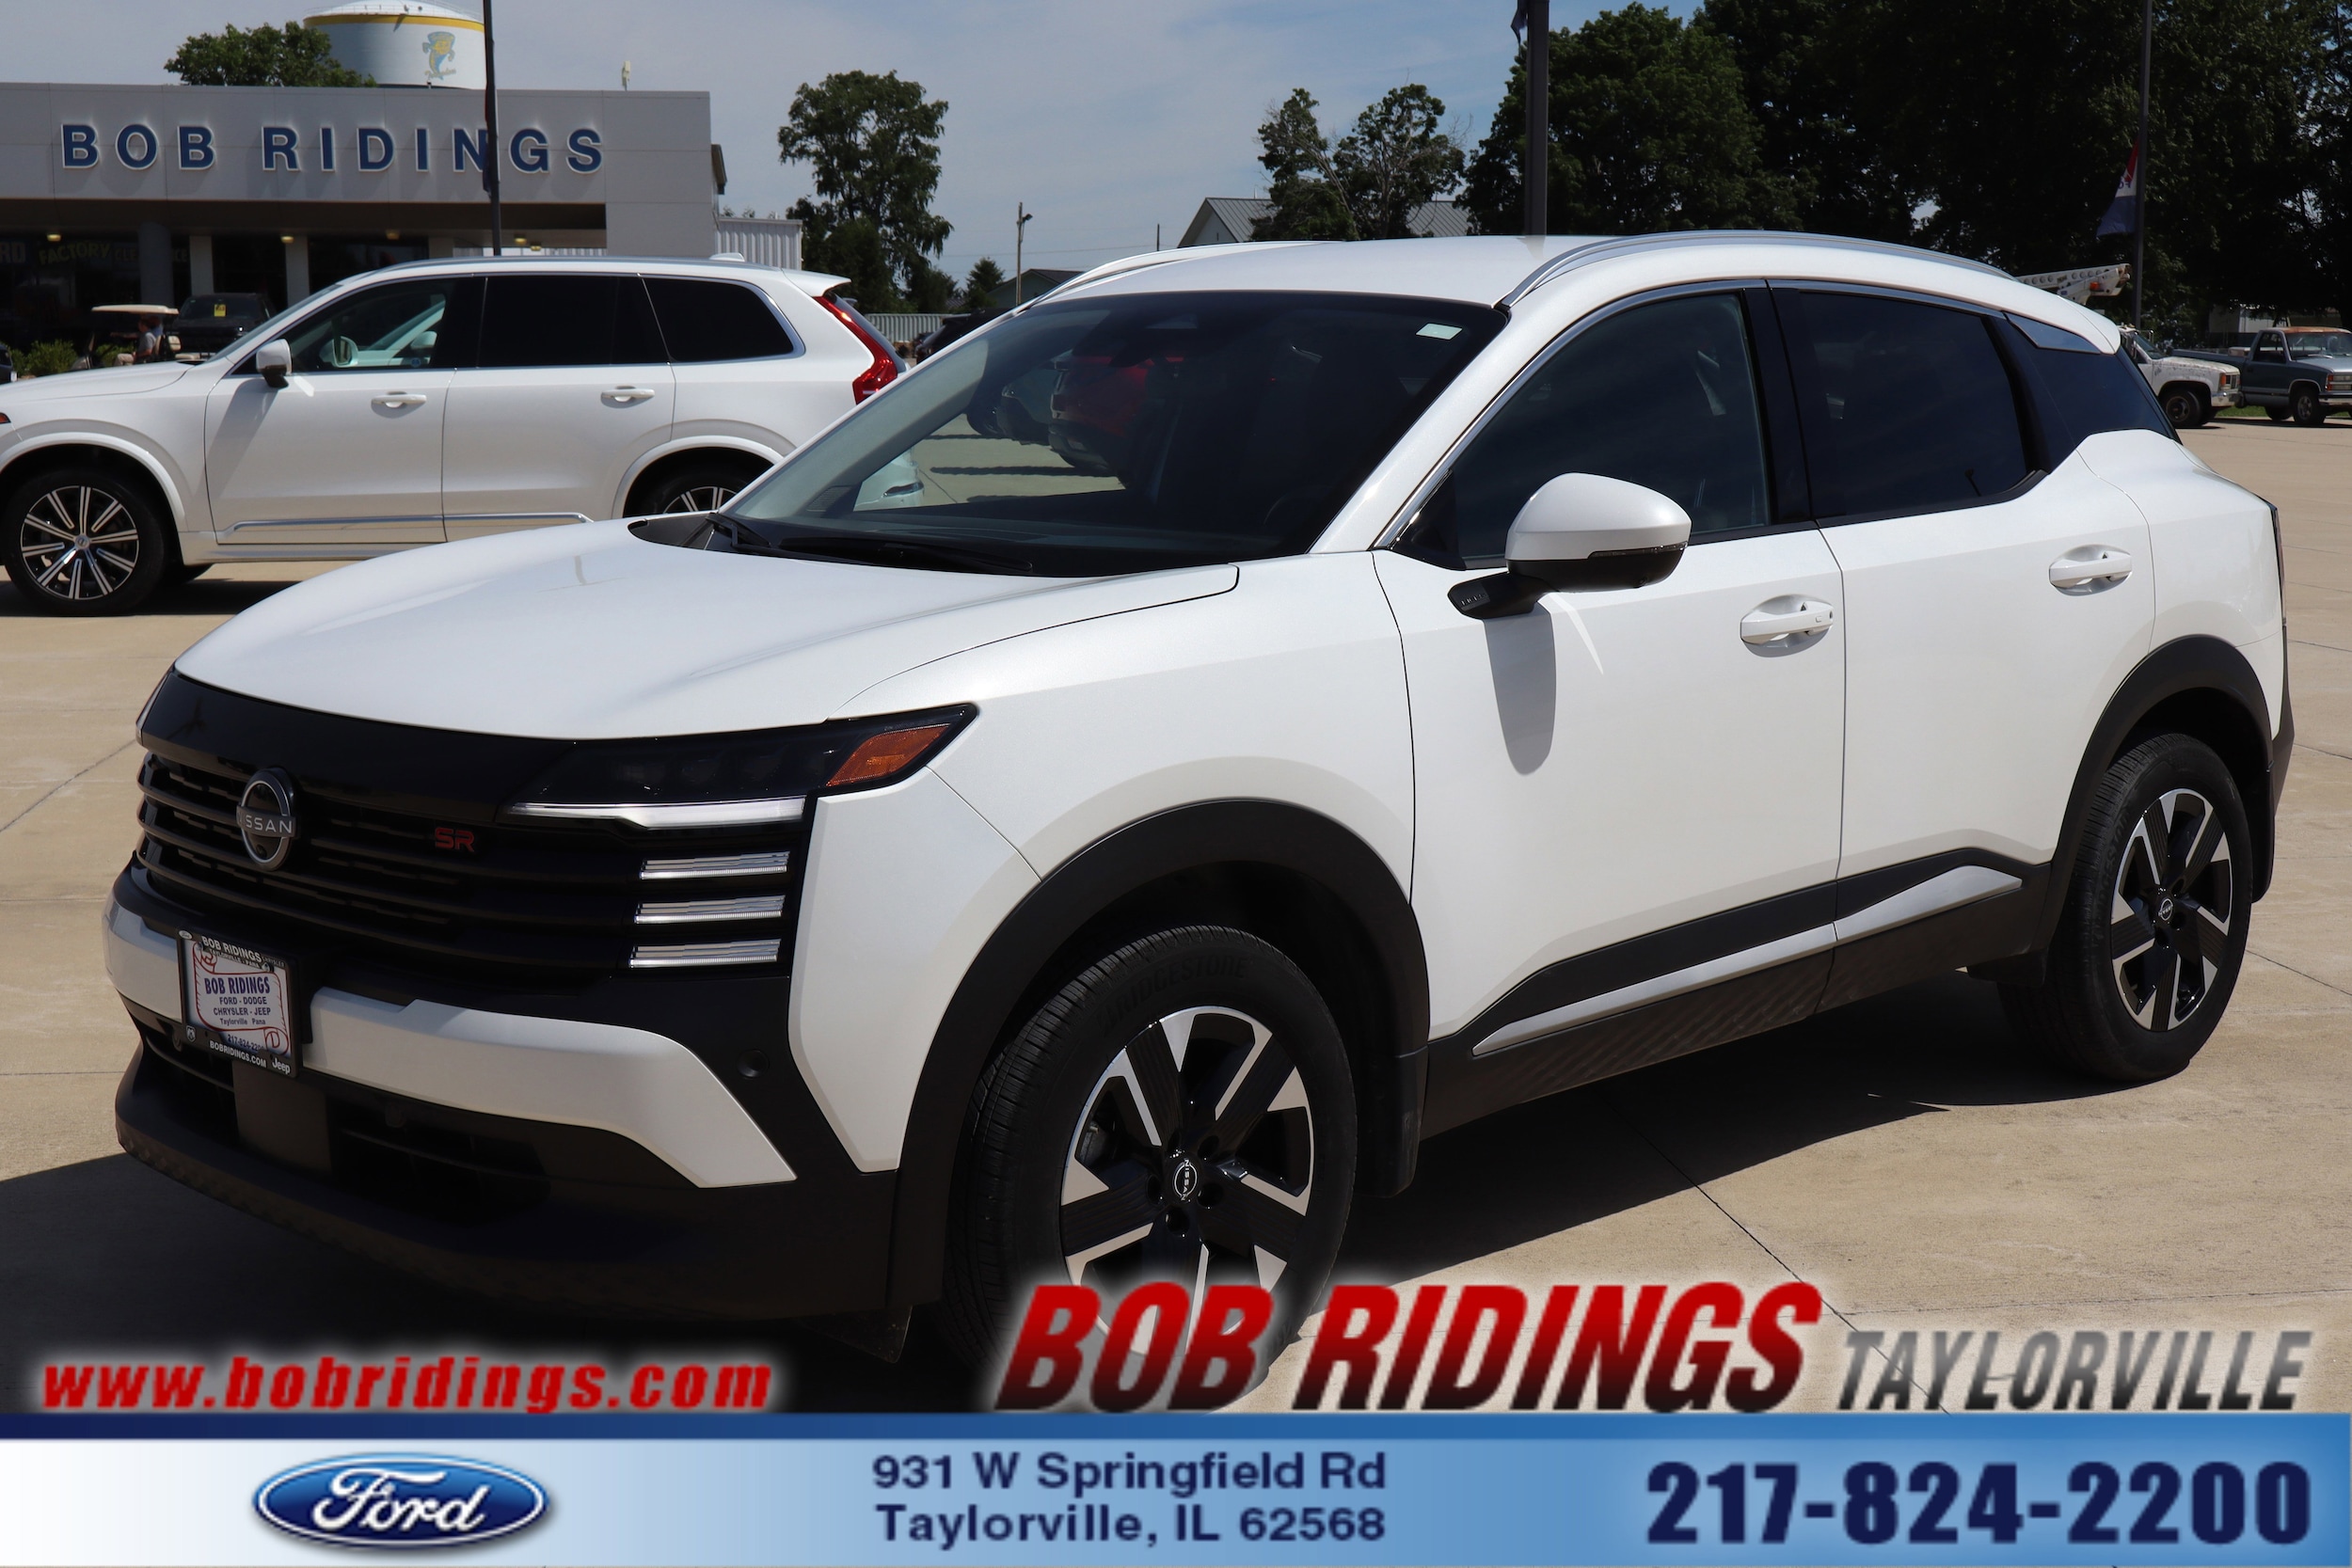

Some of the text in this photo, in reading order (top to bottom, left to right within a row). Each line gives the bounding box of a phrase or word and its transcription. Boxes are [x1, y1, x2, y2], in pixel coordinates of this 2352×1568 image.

[61, 123, 604, 175] BOB RIDINGS
[38, 240, 111, 265] FACTORY
[435, 827, 475, 852] SR
[201, 936, 262, 963] BOB RIDINGS
[204, 976, 270, 994] BOB RIDINGS
[243, 996, 267, 1005] DODGE
[214, 1007, 248, 1016] CHRYSLER
[220, 1018, 247, 1026] Taylorville
[228, 1034, 264, 1052] 217-824-220
[209, 1039, 266, 1068] BOBRIDINGS.COM
[272, 1057, 291, 1075] Jeep
